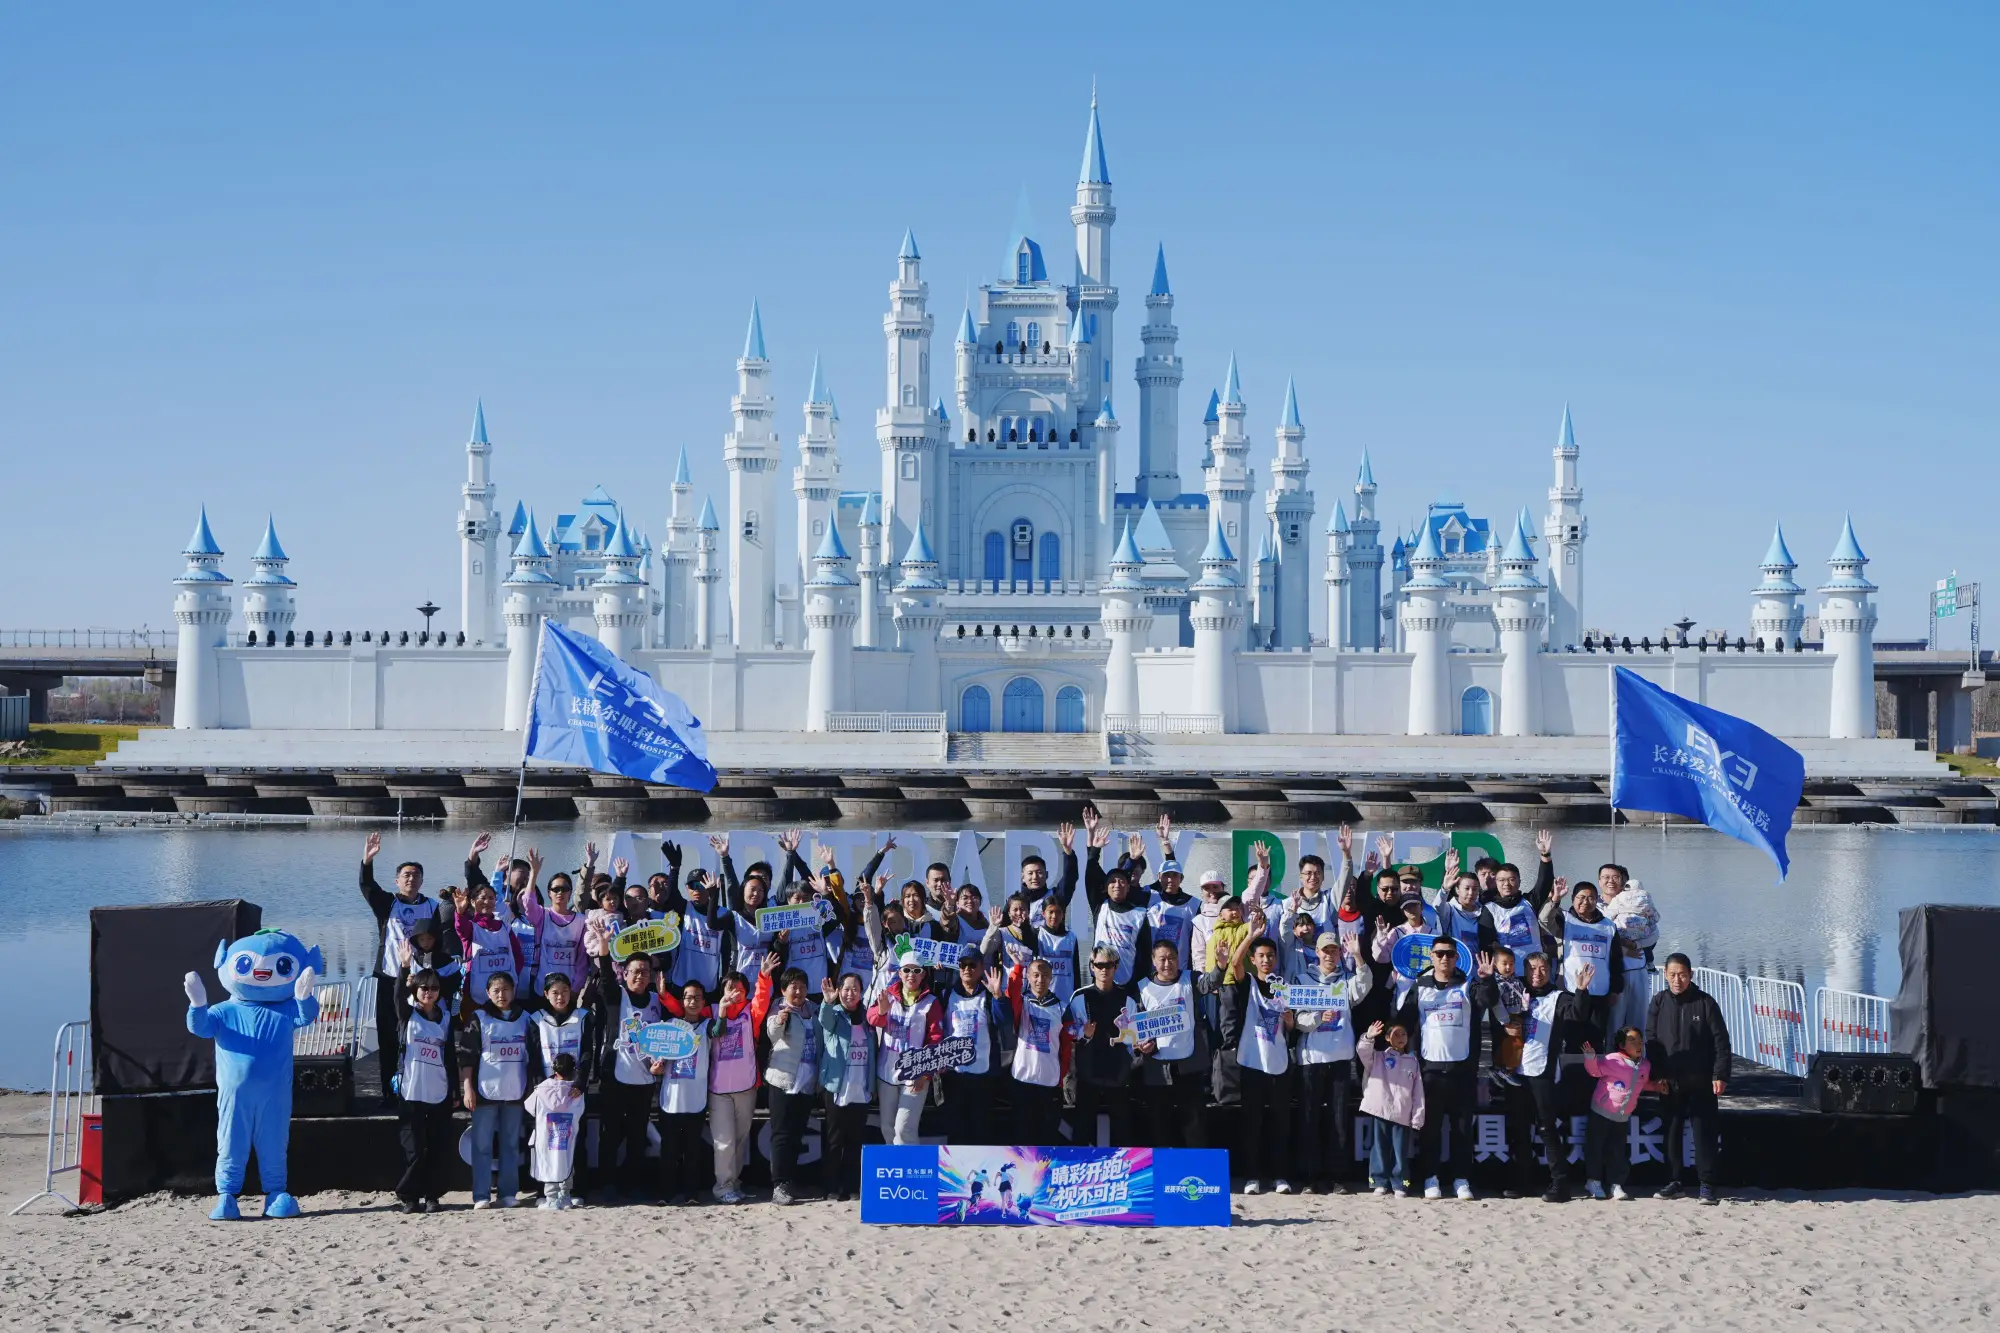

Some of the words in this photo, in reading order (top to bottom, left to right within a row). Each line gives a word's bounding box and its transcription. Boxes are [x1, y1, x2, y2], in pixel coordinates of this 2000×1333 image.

[639, 743, 685, 761] HOSPITAL
[1581, 943, 1600, 954] 003
[553, 951, 572, 961] 024
[488, 957, 506, 968] 007
[420, 1047, 438, 1059] 070
[500, 1047, 520, 1056] 004
[851, 1051, 868, 1061] 092
[1053, 1181, 1129, 1210] 视不可挡
